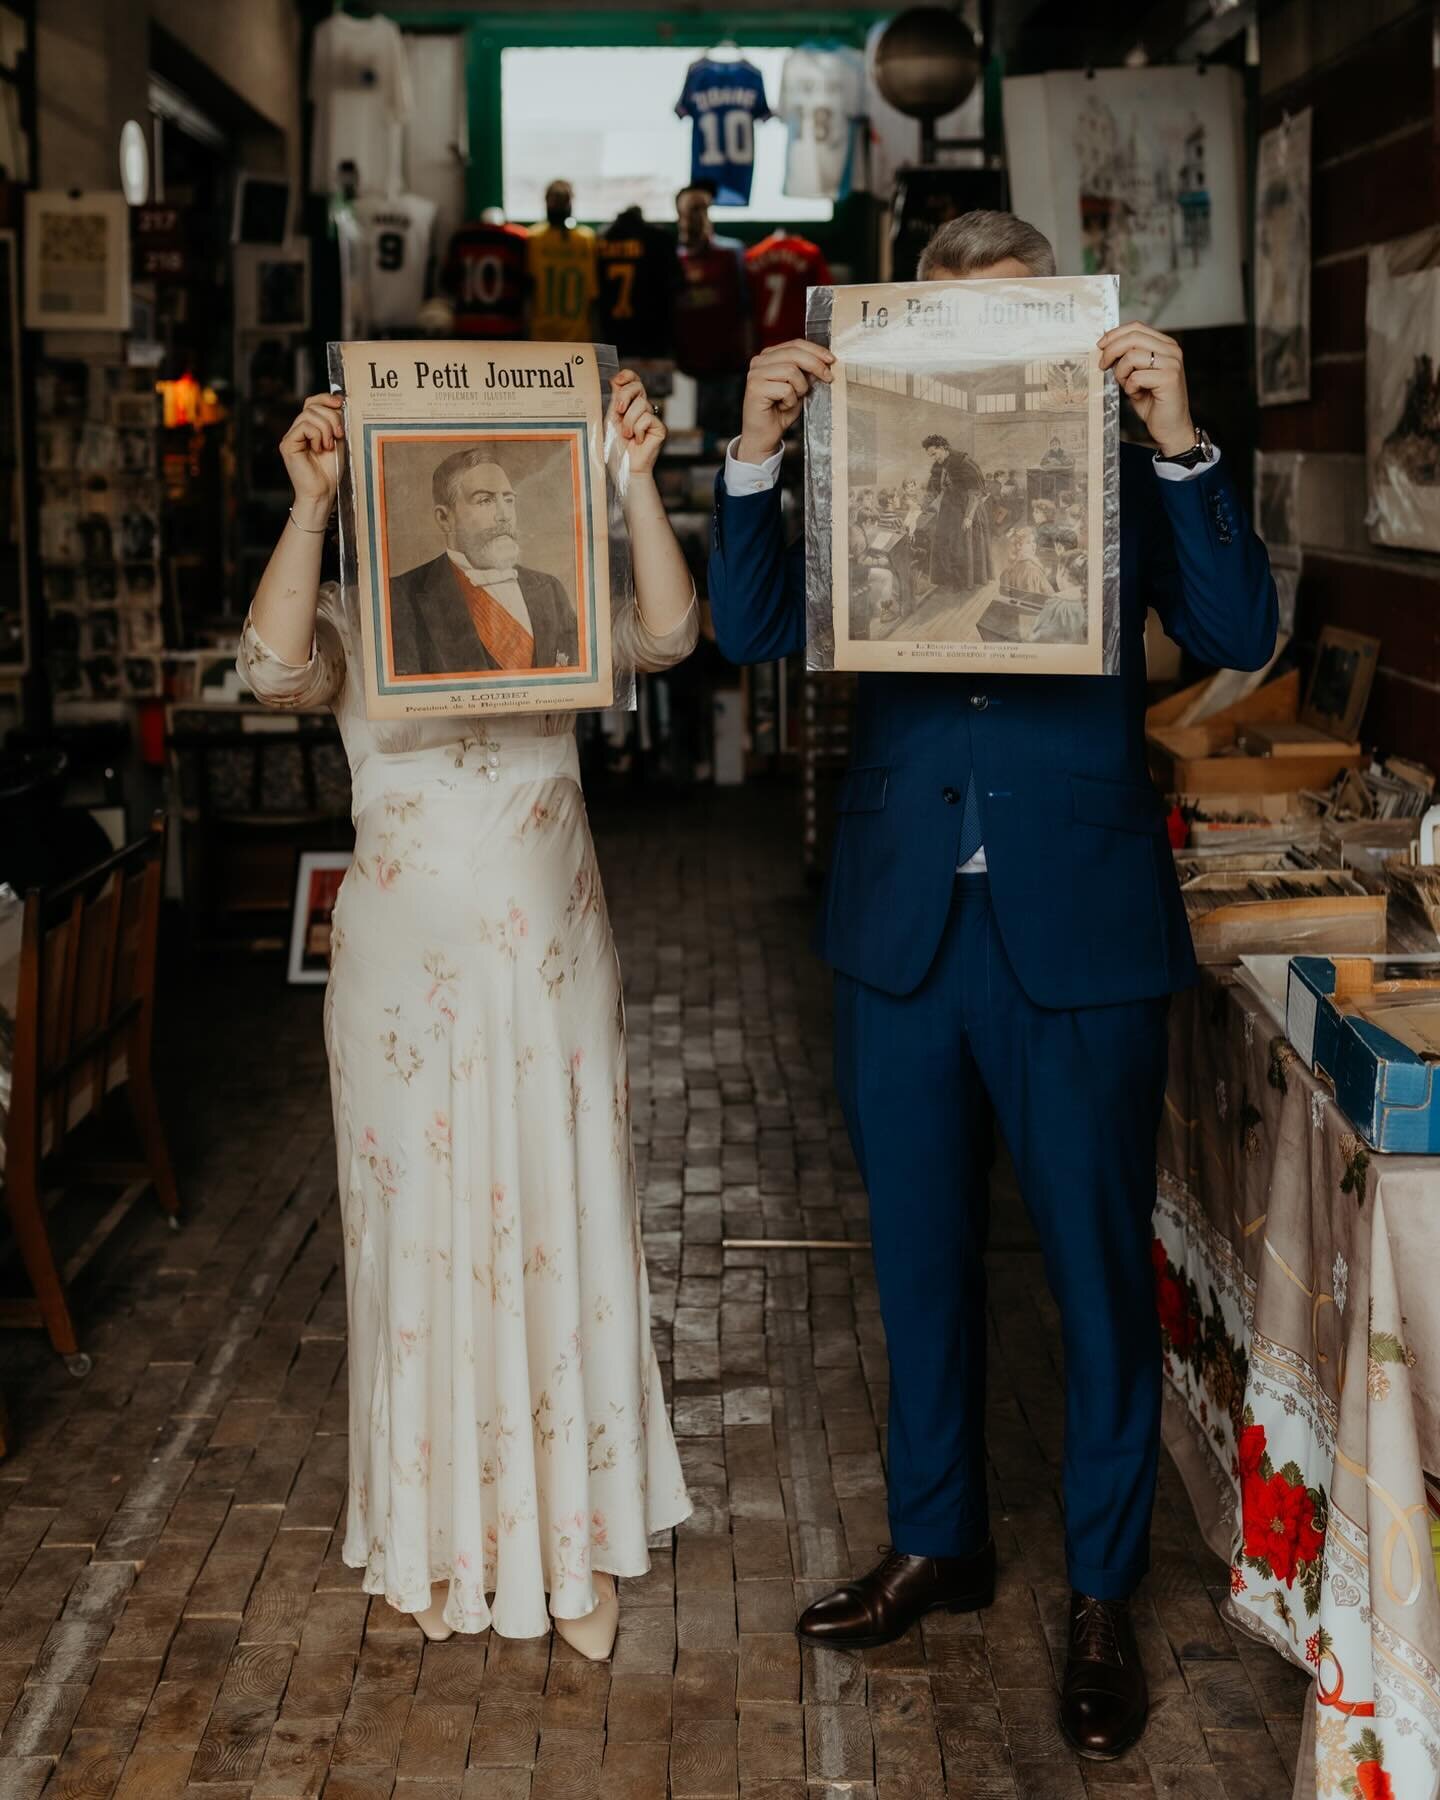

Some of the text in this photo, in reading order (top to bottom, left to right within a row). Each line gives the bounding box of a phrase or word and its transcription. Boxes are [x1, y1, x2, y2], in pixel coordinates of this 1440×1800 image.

[698, 110, 754, 166] 10
[378, 231, 404, 272] 9
[463, 253, 505, 304] 10
[543, 264, 586, 318] 10
[606, 262, 637, 319] 7
[763, 273, 787, 328] 7
[860, 294, 1076, 329] Le Petit Journal
[368, 361, 575, 389] Le Petit Journal
[471, 692, 529, 701] LOUBET
